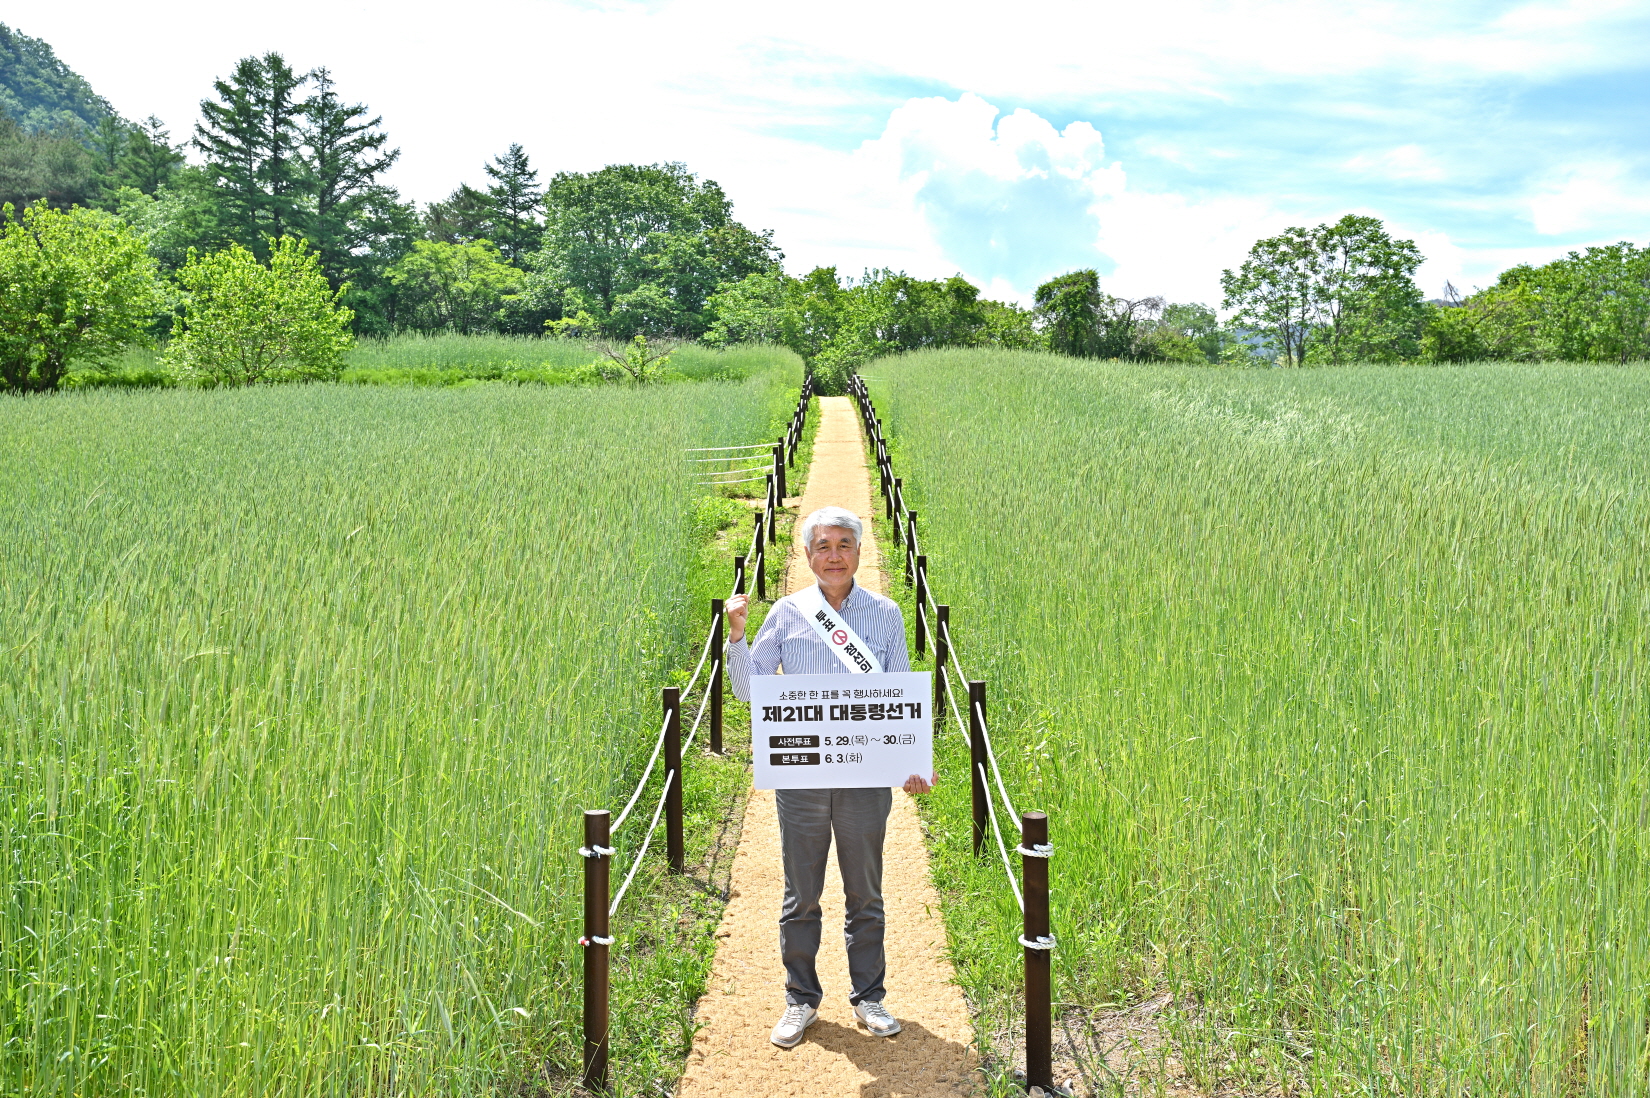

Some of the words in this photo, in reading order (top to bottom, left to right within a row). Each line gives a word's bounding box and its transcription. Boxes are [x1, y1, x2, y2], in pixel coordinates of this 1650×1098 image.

[815, 610, 835, 632] 투표
[844, 643, 872, 673] 정선의
[779, 690, 806, 700] 소중한
[809, 690, 818, 699] 한
[821, 690, 839, 699] 표를
[842, 690, 851, 699] 꼭
[854, 689, 903, 698] 행사하세요!
[762, 705, 823, 722] 제21대
[830, 703, 921, 721] 대통령선거
[778, 738, 811, 746] 사전투표
[782, 755, 809, 763] 본투표
